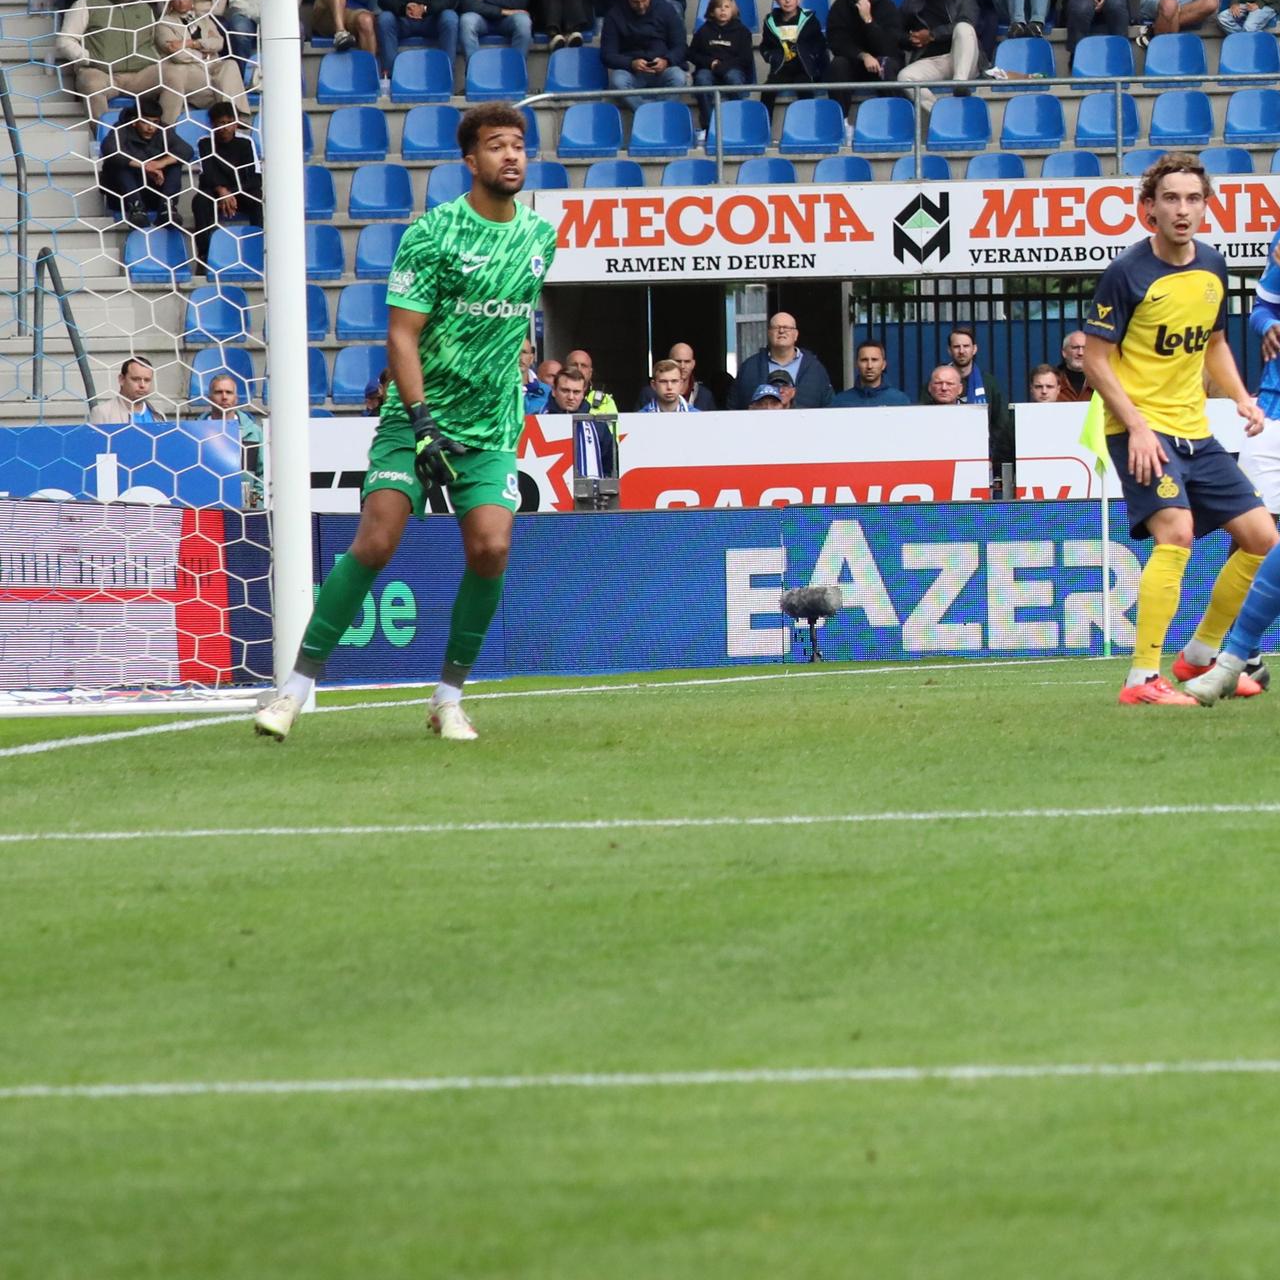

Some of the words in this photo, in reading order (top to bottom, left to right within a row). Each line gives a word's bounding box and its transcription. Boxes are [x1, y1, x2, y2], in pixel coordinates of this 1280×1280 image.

[556, 193, 875, 248] MECONA
[605, 256, 686, 273] RAMEN
[692, 255, 722, 271] EN
[728, 253, 817, 270] DEUREN
[968, 245, 1132, 264] VERANDABOU
[725, 519, 1141, 658] EAZER
